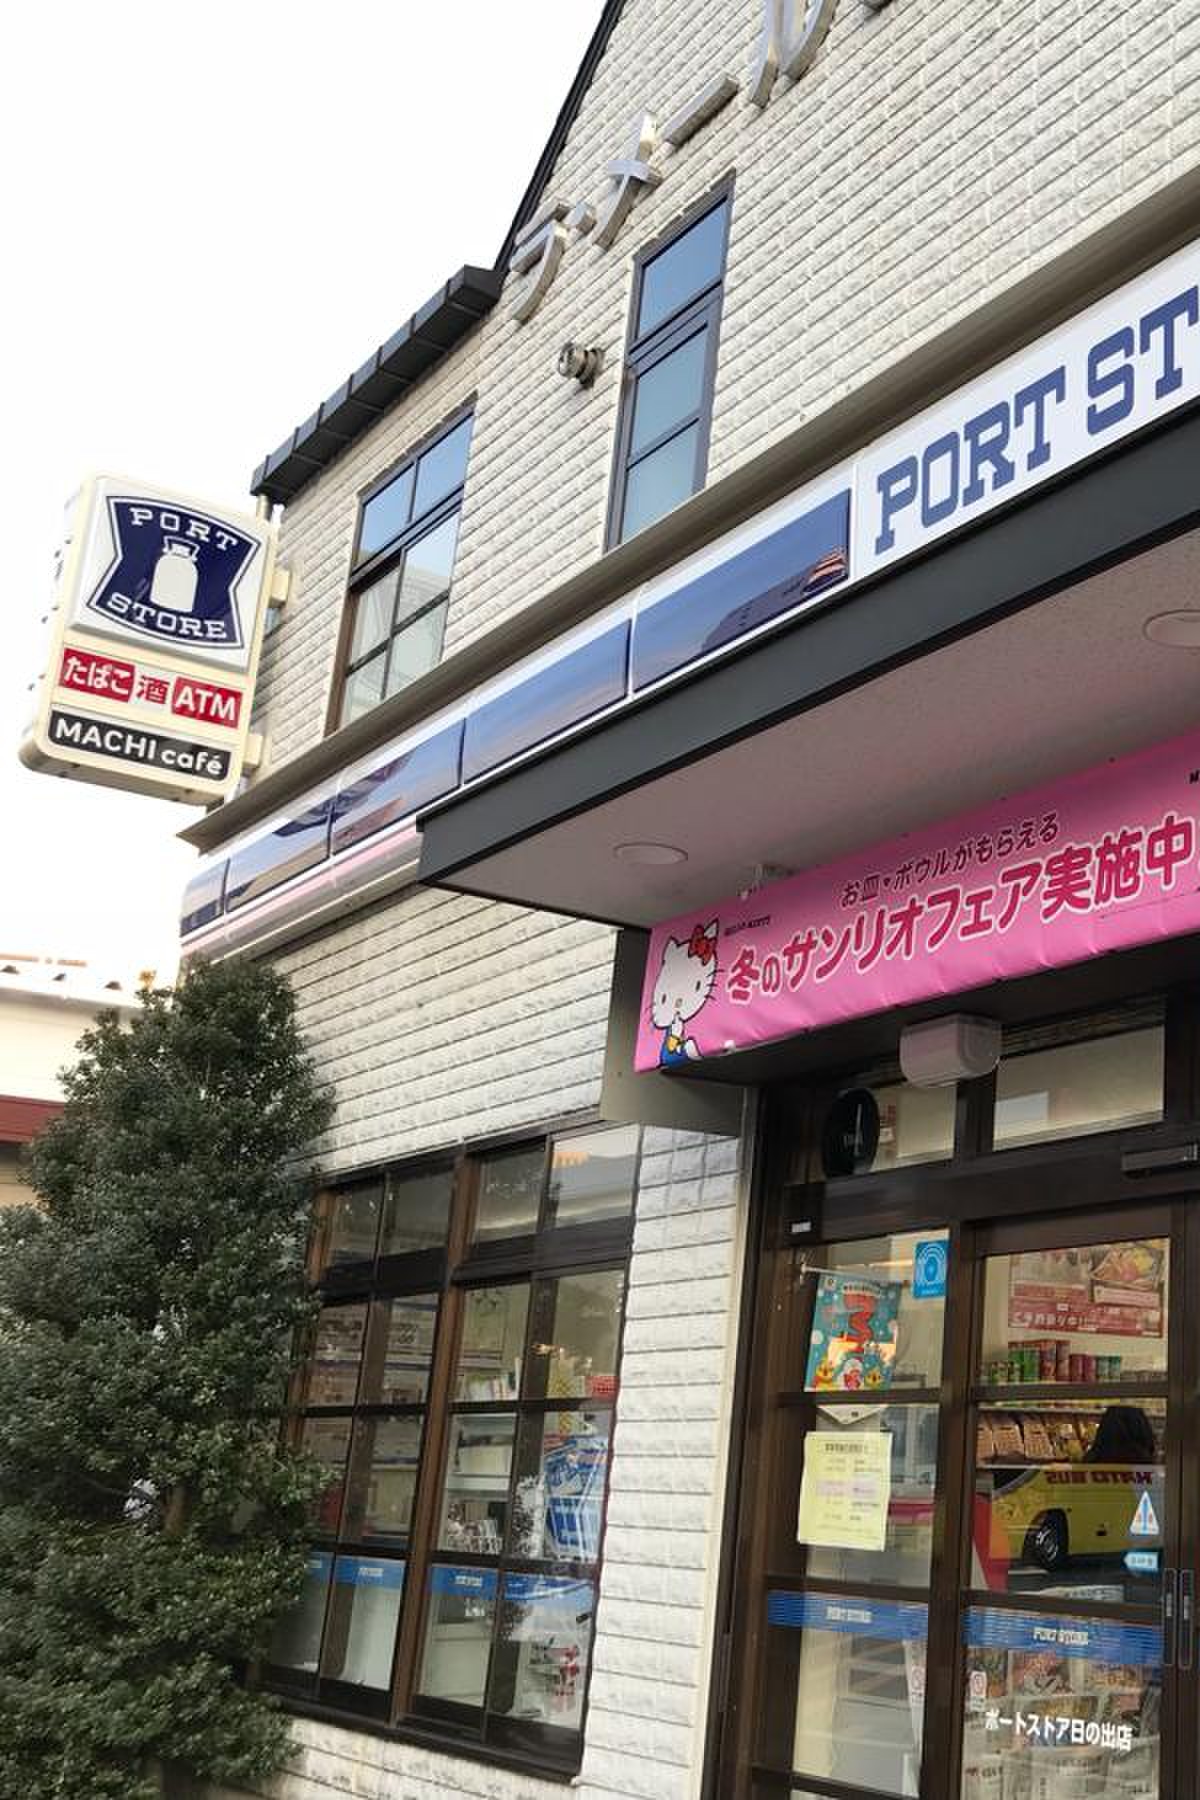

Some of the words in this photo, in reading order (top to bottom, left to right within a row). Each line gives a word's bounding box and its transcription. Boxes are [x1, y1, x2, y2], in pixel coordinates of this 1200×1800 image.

[875, 365, 1066, 555] PORT
[130, 506, 239, 551] PORT
[107, 592, 228, 639] STORE
[63, 656, 134, 695] たばこ
[137, 674, 170, 705] 酒
[176, 684, 239, 722] ATM
[56, 718, 157, 760] MACHI
[161, 747, 223, 776] café
[985, 1708, 1133, 1751] ポートストア日の出店
